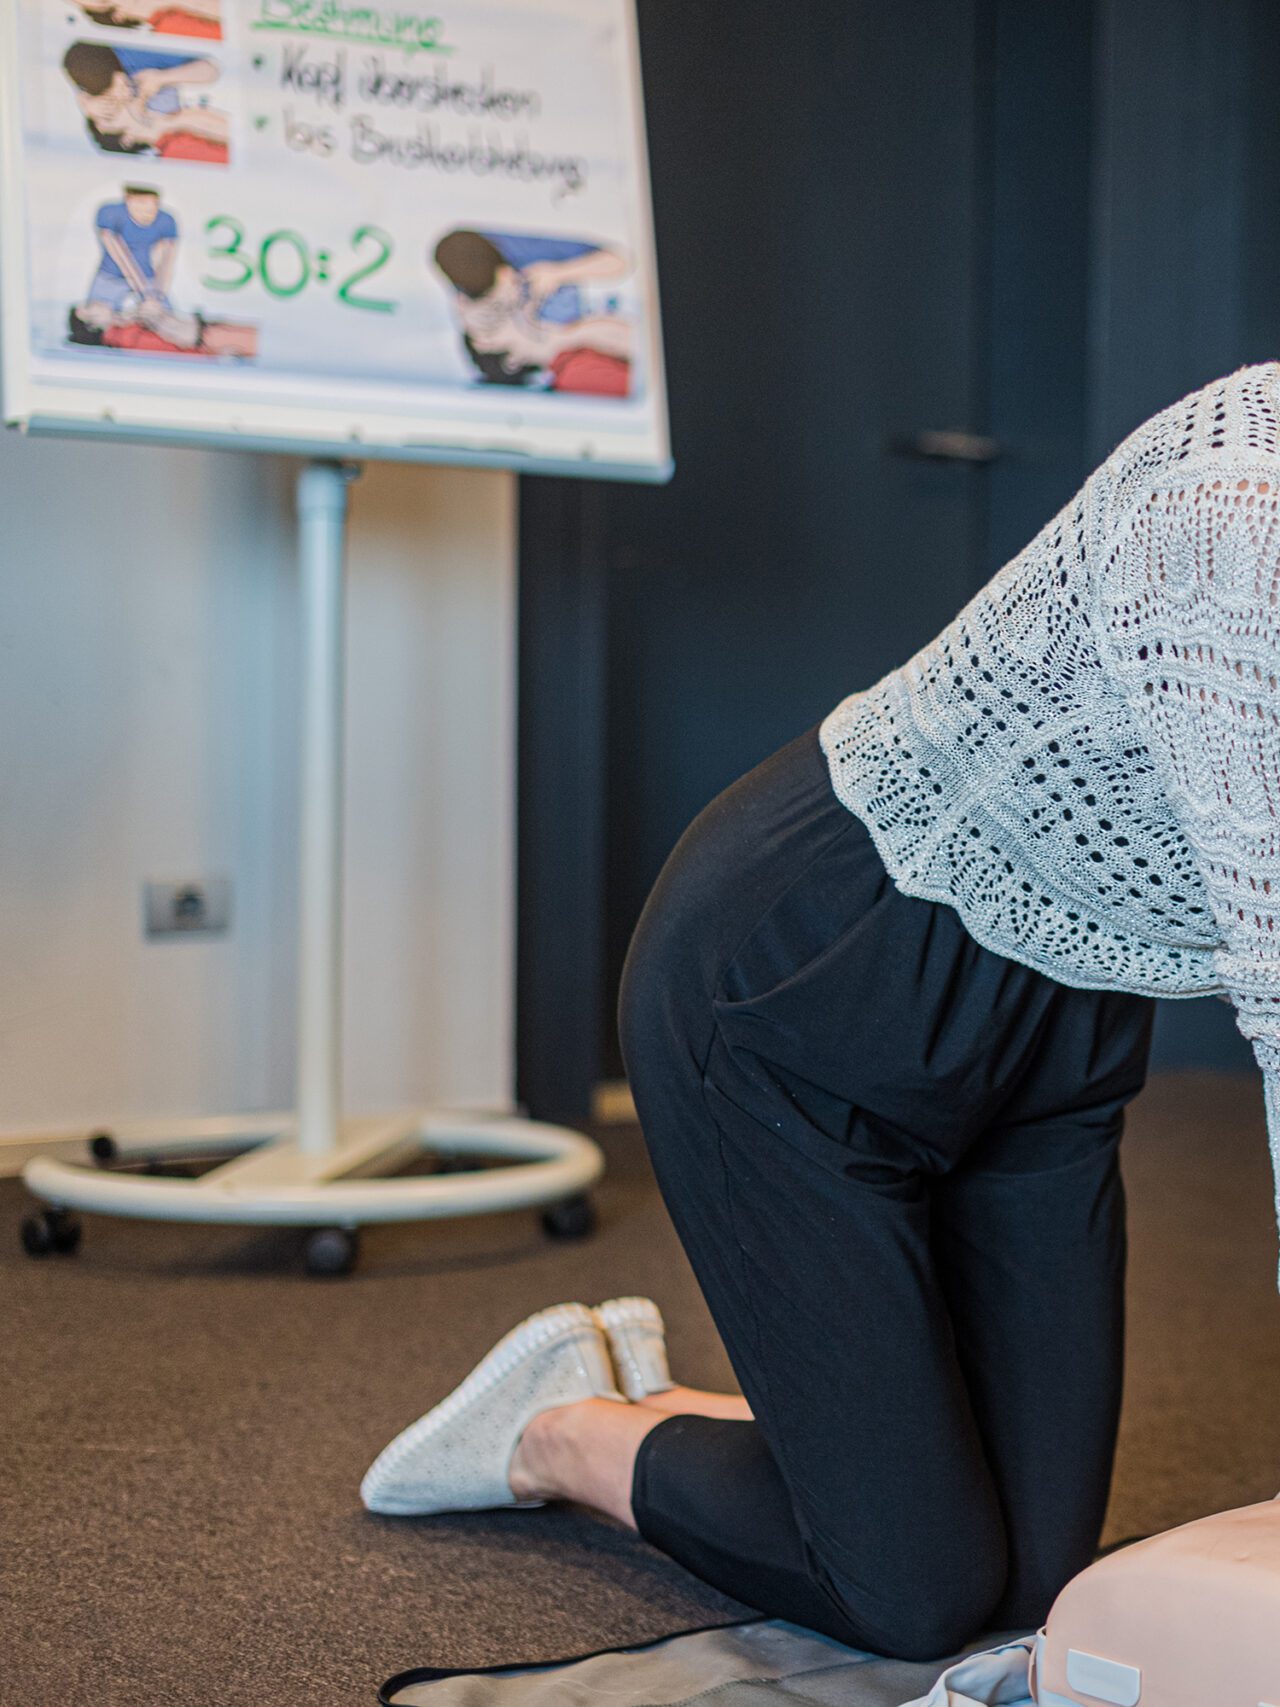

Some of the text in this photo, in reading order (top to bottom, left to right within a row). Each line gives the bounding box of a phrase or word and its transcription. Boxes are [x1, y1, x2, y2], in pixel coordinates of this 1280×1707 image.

[281, 45, 345, 112] Kopf
[283, 108, 337, 156] bis
[203, 215, 397, 313] 30:2
